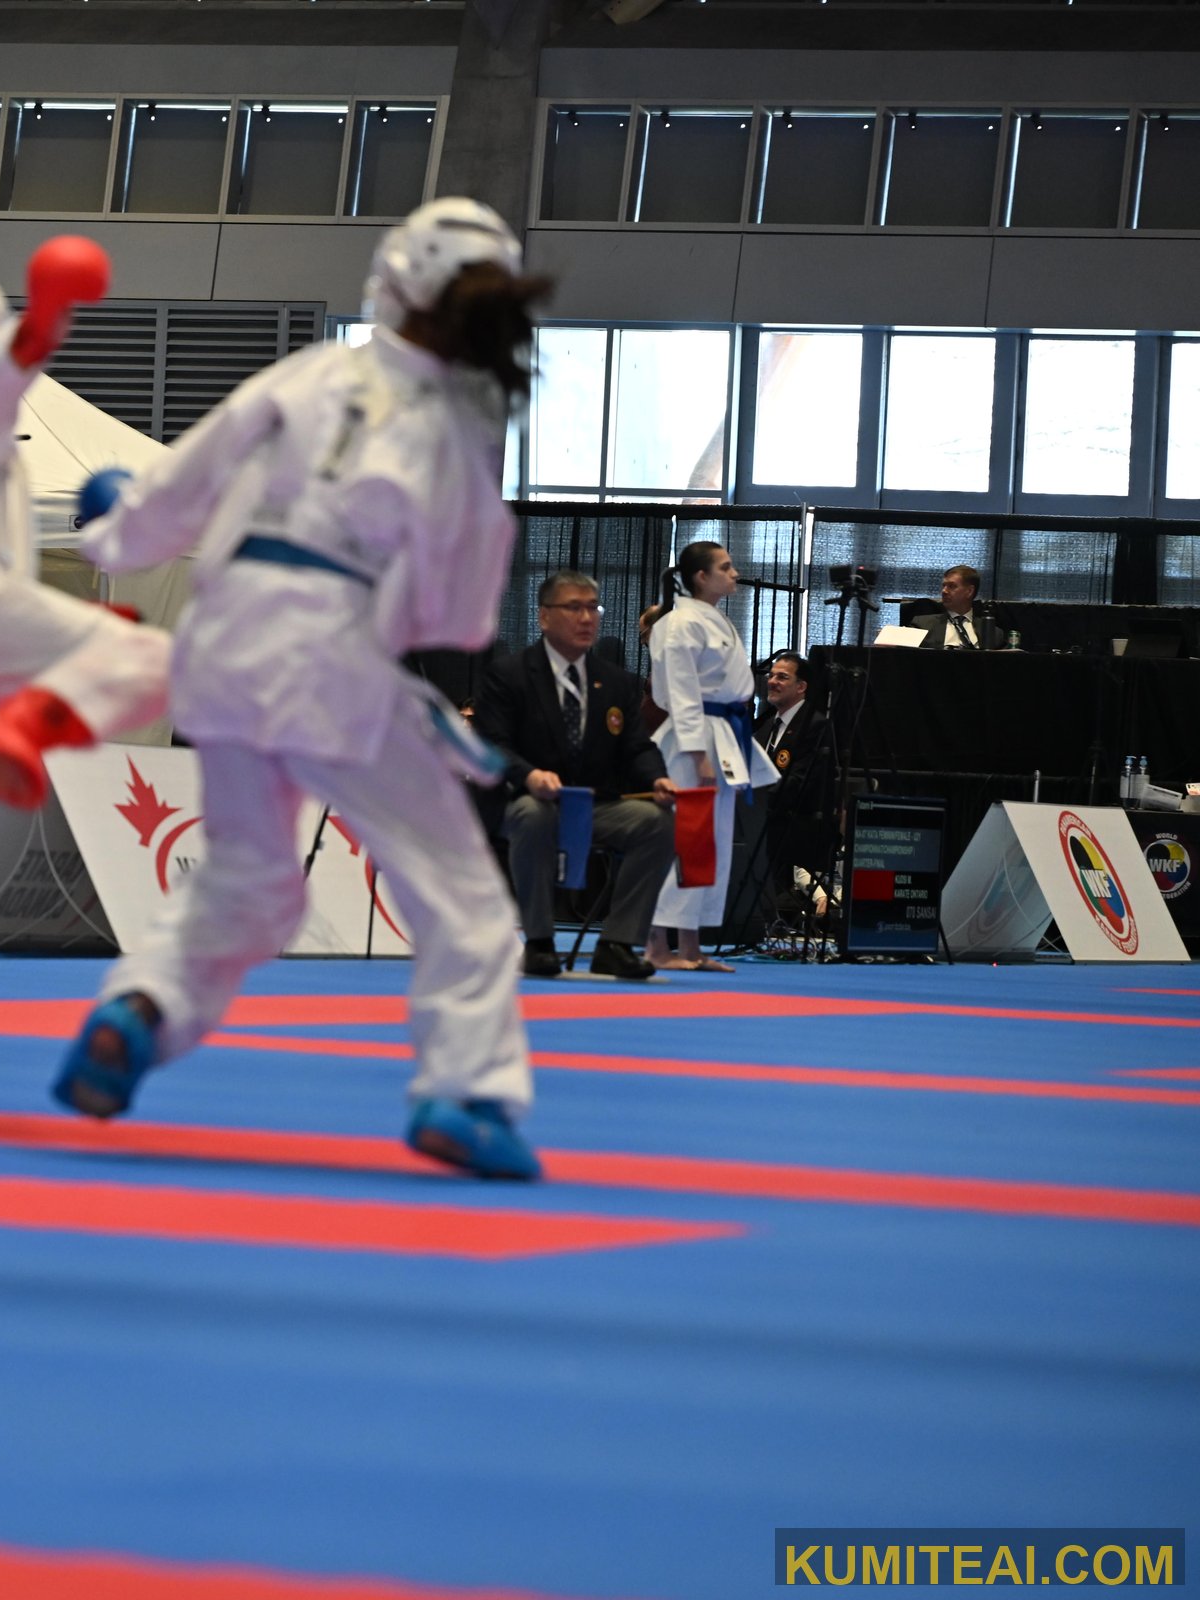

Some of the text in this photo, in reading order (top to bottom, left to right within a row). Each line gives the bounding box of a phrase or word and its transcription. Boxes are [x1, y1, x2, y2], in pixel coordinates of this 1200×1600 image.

[1155, 832, 1179, 840] WORLD
[1148, 858, 1181, 873] WKF
[1080, 867, 1112, 898] WKF
